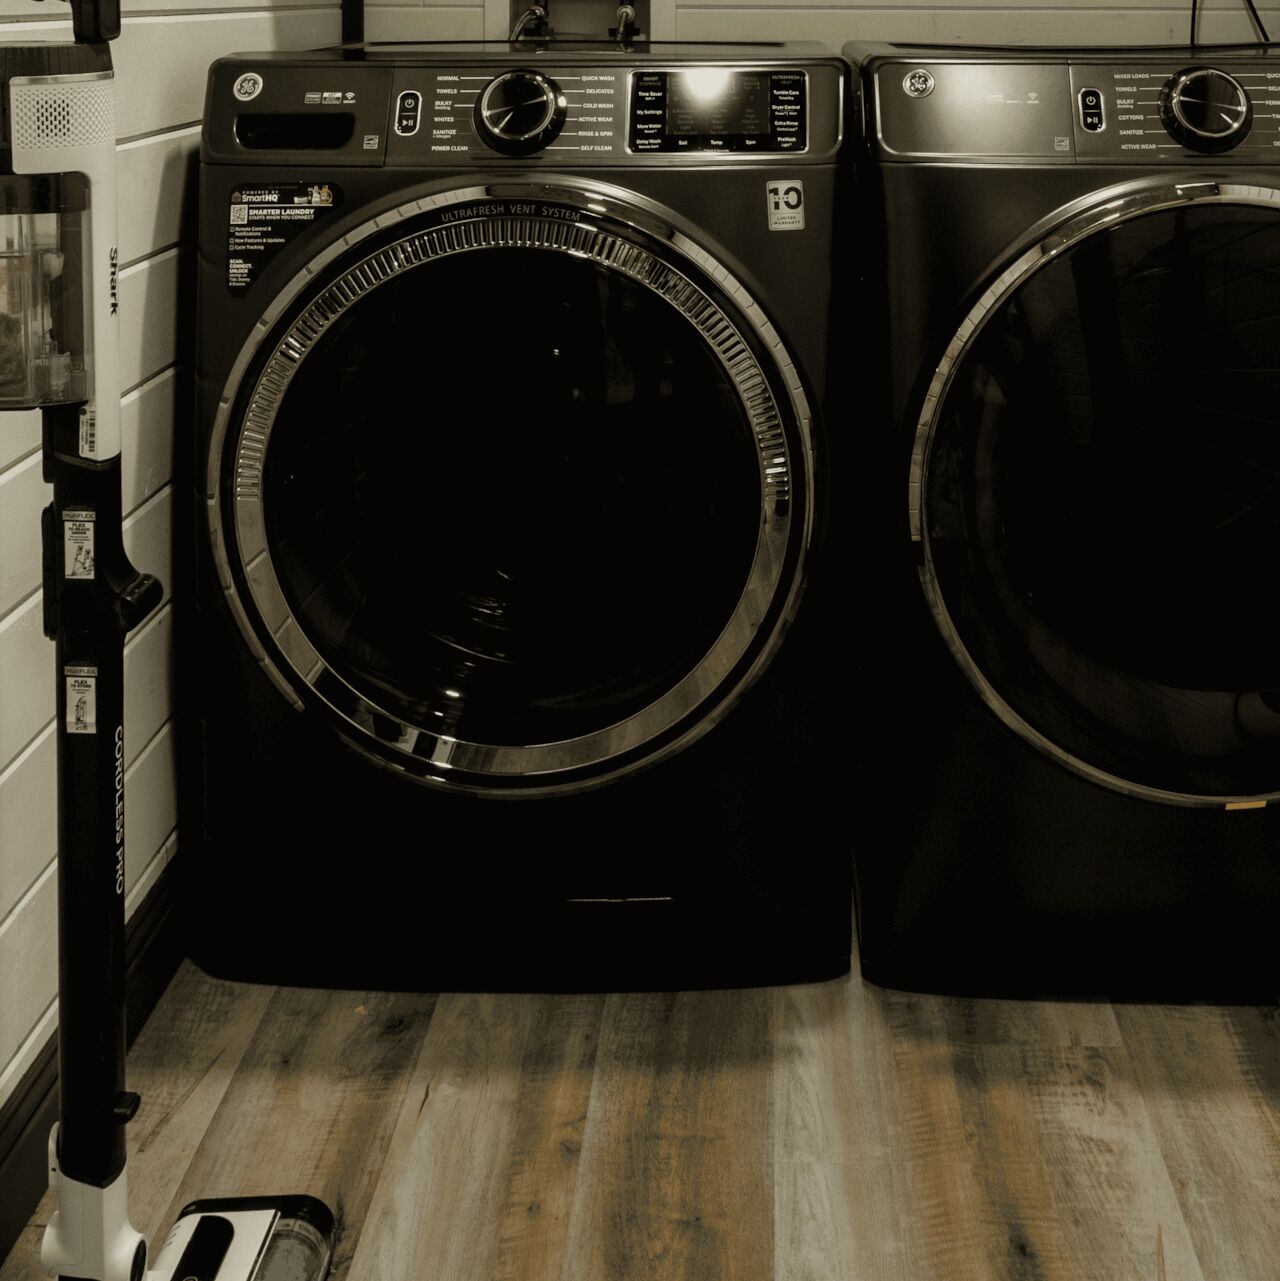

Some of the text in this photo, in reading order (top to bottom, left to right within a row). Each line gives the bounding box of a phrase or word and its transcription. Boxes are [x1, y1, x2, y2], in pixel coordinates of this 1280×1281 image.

[242, 194, 278, 202] SmartHQ
[769, 186, 802, 210] 10
[441, 204, 581, 222] ULTRAFRESH VENT SYSTEM
[110, 246, 118, 317] Shark
[115, 725, 123, 844] CORDLESS
